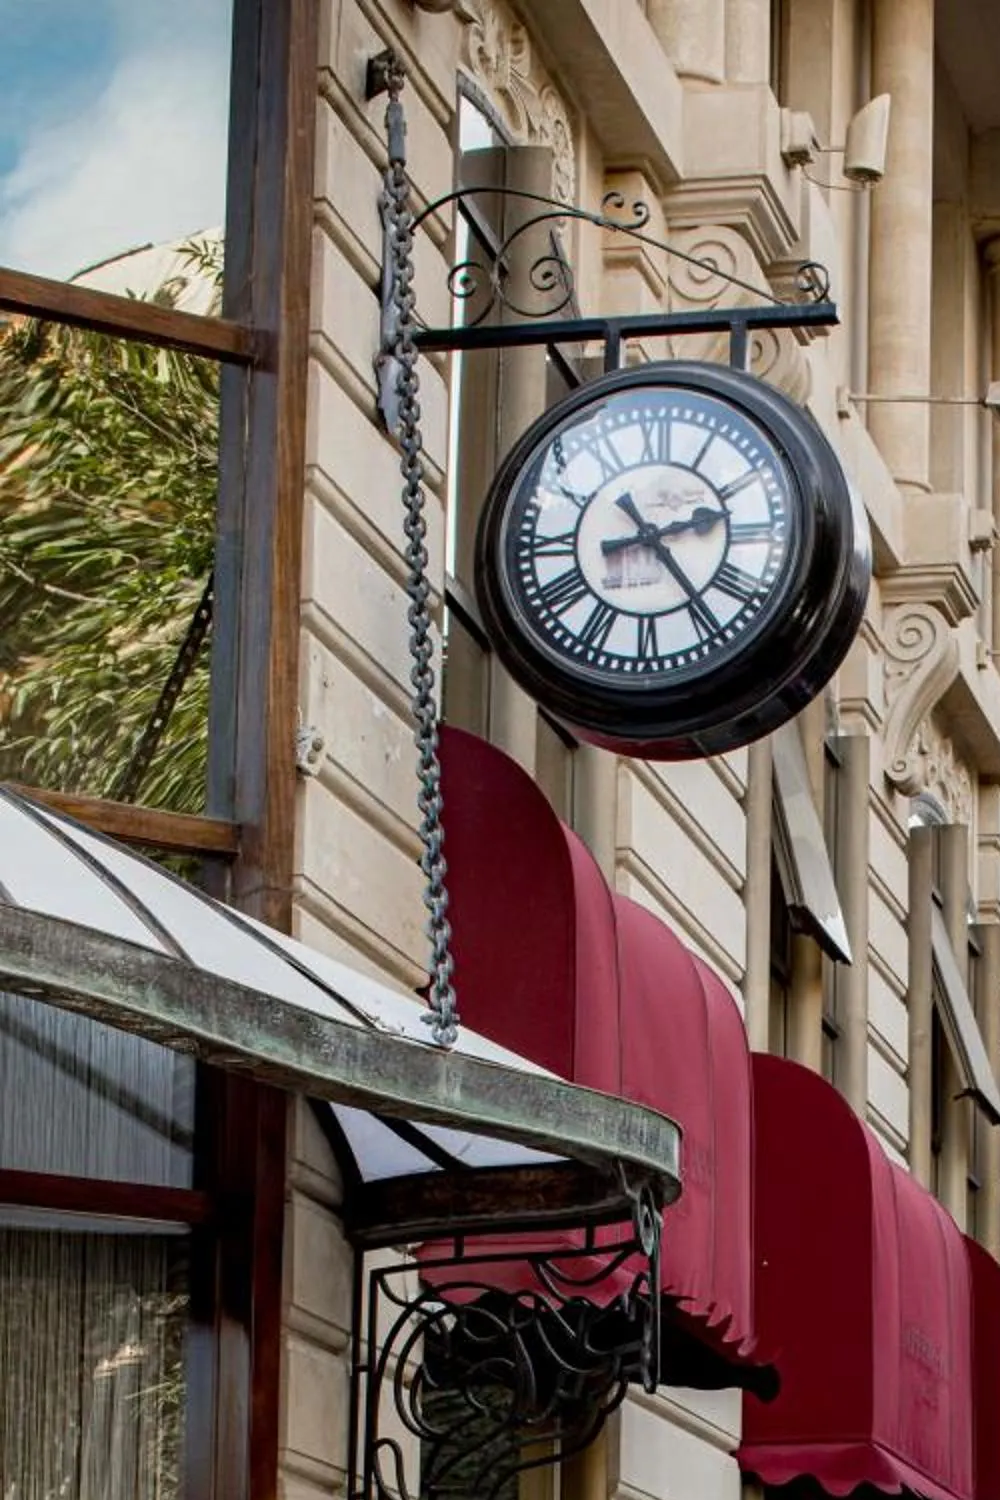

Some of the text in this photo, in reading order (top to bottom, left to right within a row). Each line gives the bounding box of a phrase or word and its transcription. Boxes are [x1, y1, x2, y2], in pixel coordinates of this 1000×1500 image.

[640, 420, 671, 462] XII
[718, 466, 763, 501] II
[533, 530, 577, 556] IX
[541, 567, 593, 618] VIII
[712, 561, 766, 604] IIII
[577, 604, 619, 652] VII
[637, 616, 659, 658] VI
